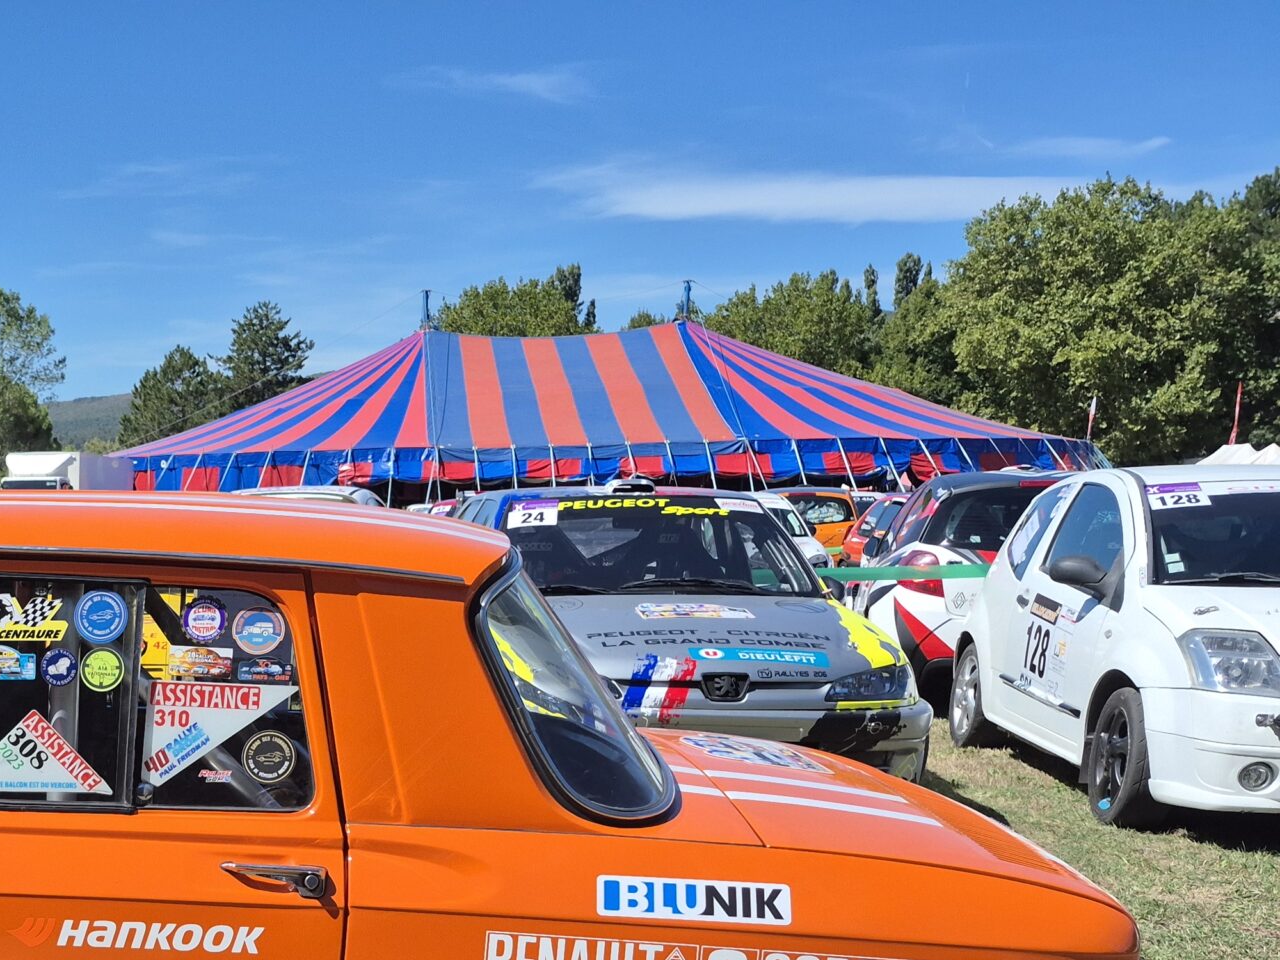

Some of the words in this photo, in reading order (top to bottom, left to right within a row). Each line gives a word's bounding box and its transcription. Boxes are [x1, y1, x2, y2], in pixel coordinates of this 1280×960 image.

[558, 498, 670, 511] PEUGEOT
[1155, 494, 1201, 507] 128
[521, 512, 545, 524] 24
[587, 629, 699, 639] PEUGEOT
[601, 640, 631, 648] LA
[645, 638, 731, 646] GRAND
[1024, 621, 1050, 679] 128
[738, 652, 817, 664] DIEULEFIT
[153, 683, 260, 710] ASSISTANCE
[154, 710, 190, 727] 310
[165, 722, 198, 752] RALLYE
[7, 727, 49, 770] 308
[23, 714, 101, 790] ASSISTANCE
[159, 763, 177, 779] PAUL
[603, 879, 785, 921] BLUNIK
